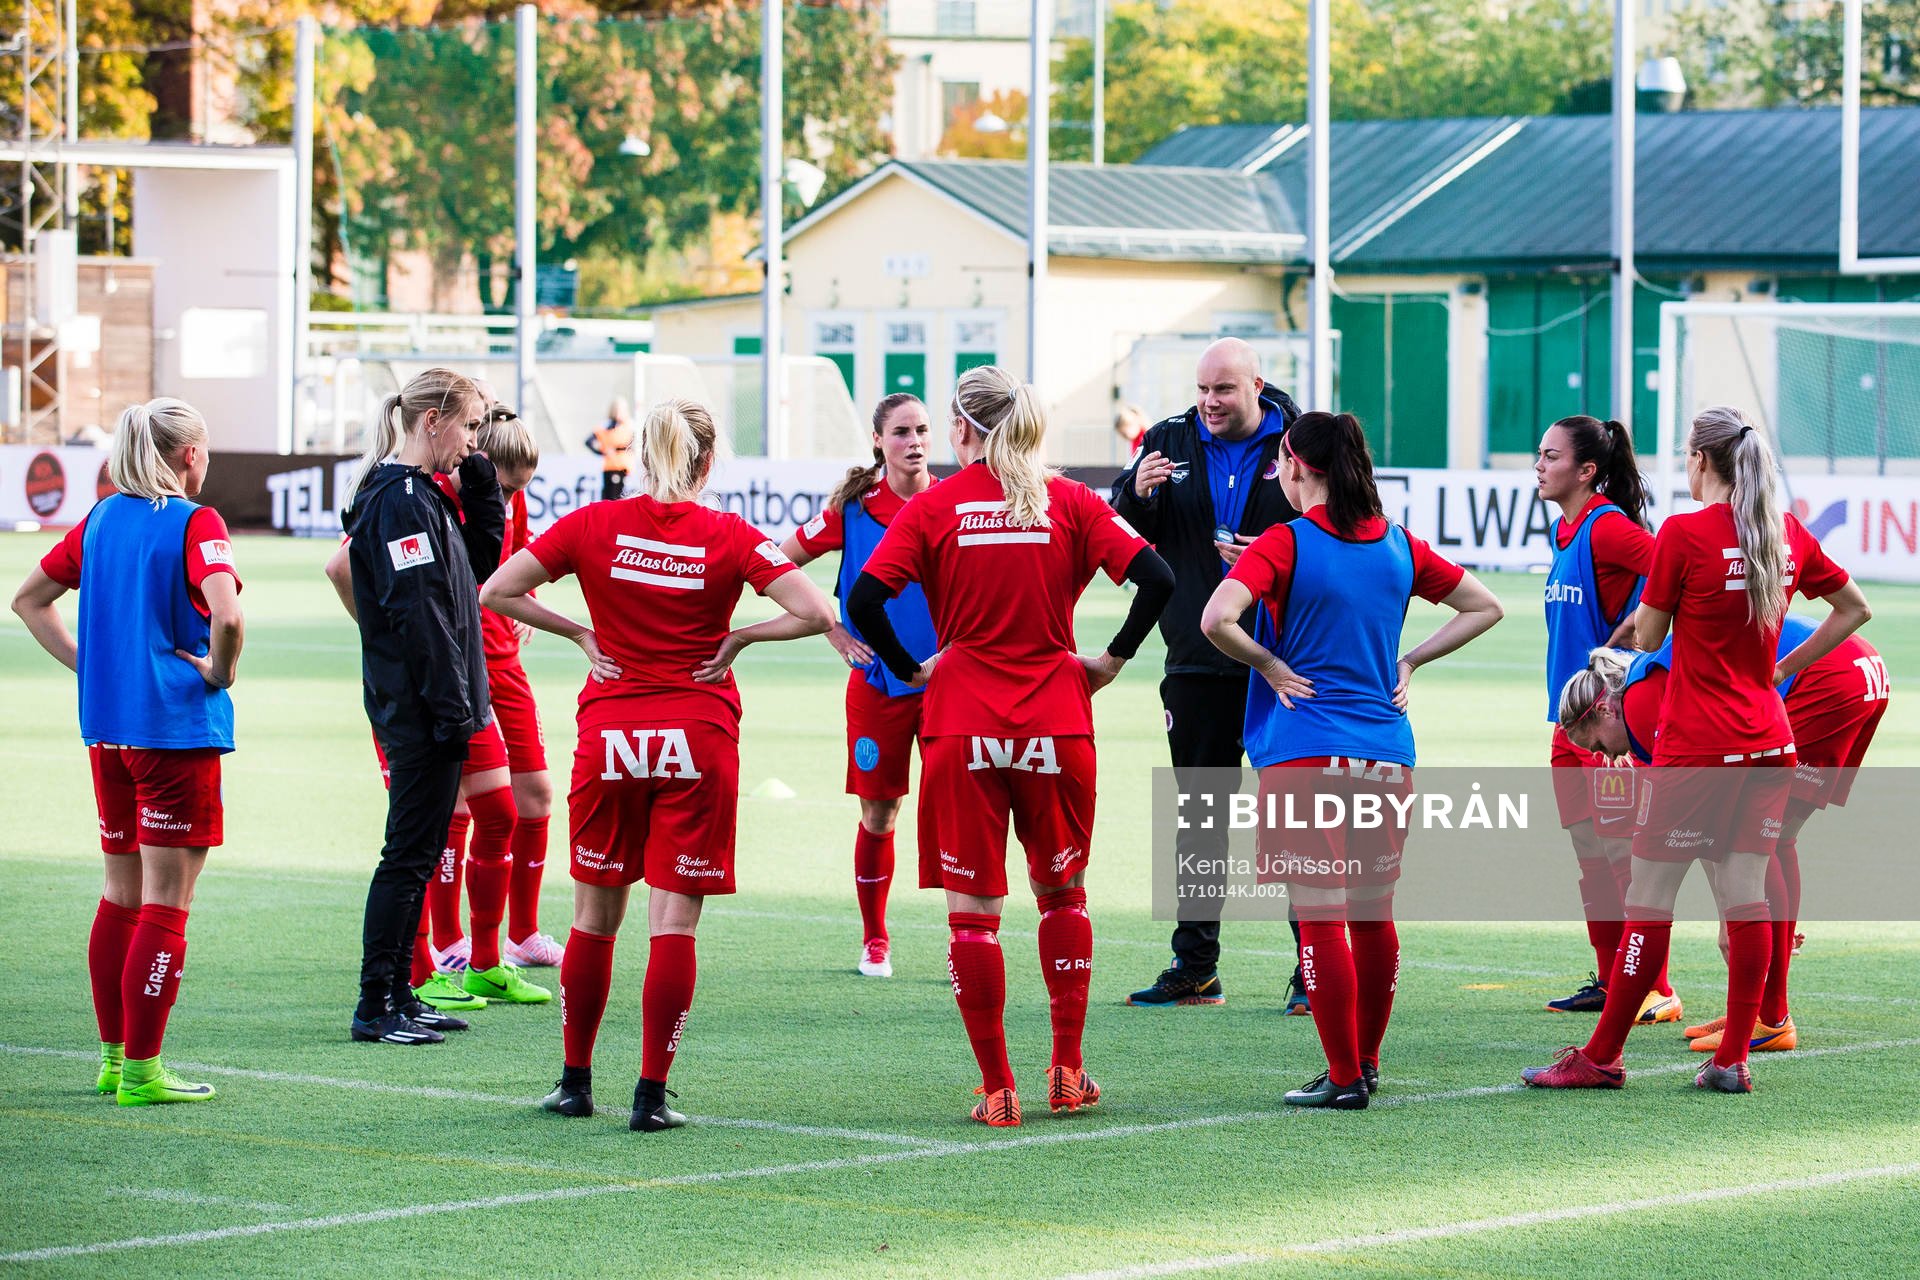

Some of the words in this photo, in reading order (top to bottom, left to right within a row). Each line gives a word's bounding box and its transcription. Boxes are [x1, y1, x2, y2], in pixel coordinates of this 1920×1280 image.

[527, 476, 597, 519] Sefi
[957, 514, 1003, 531] Atlas
[612, 548, 660, 570] Atlas
[661, 556, 705, 576] Copco
[601, 728, 702, 780] NA
[968, 736, 1062, 774] NA
[149, 951, 172, 983] Rätt
[1303, 959, 1317, 991] Rätt
[1623, 944, 1642, 977] Rätt
